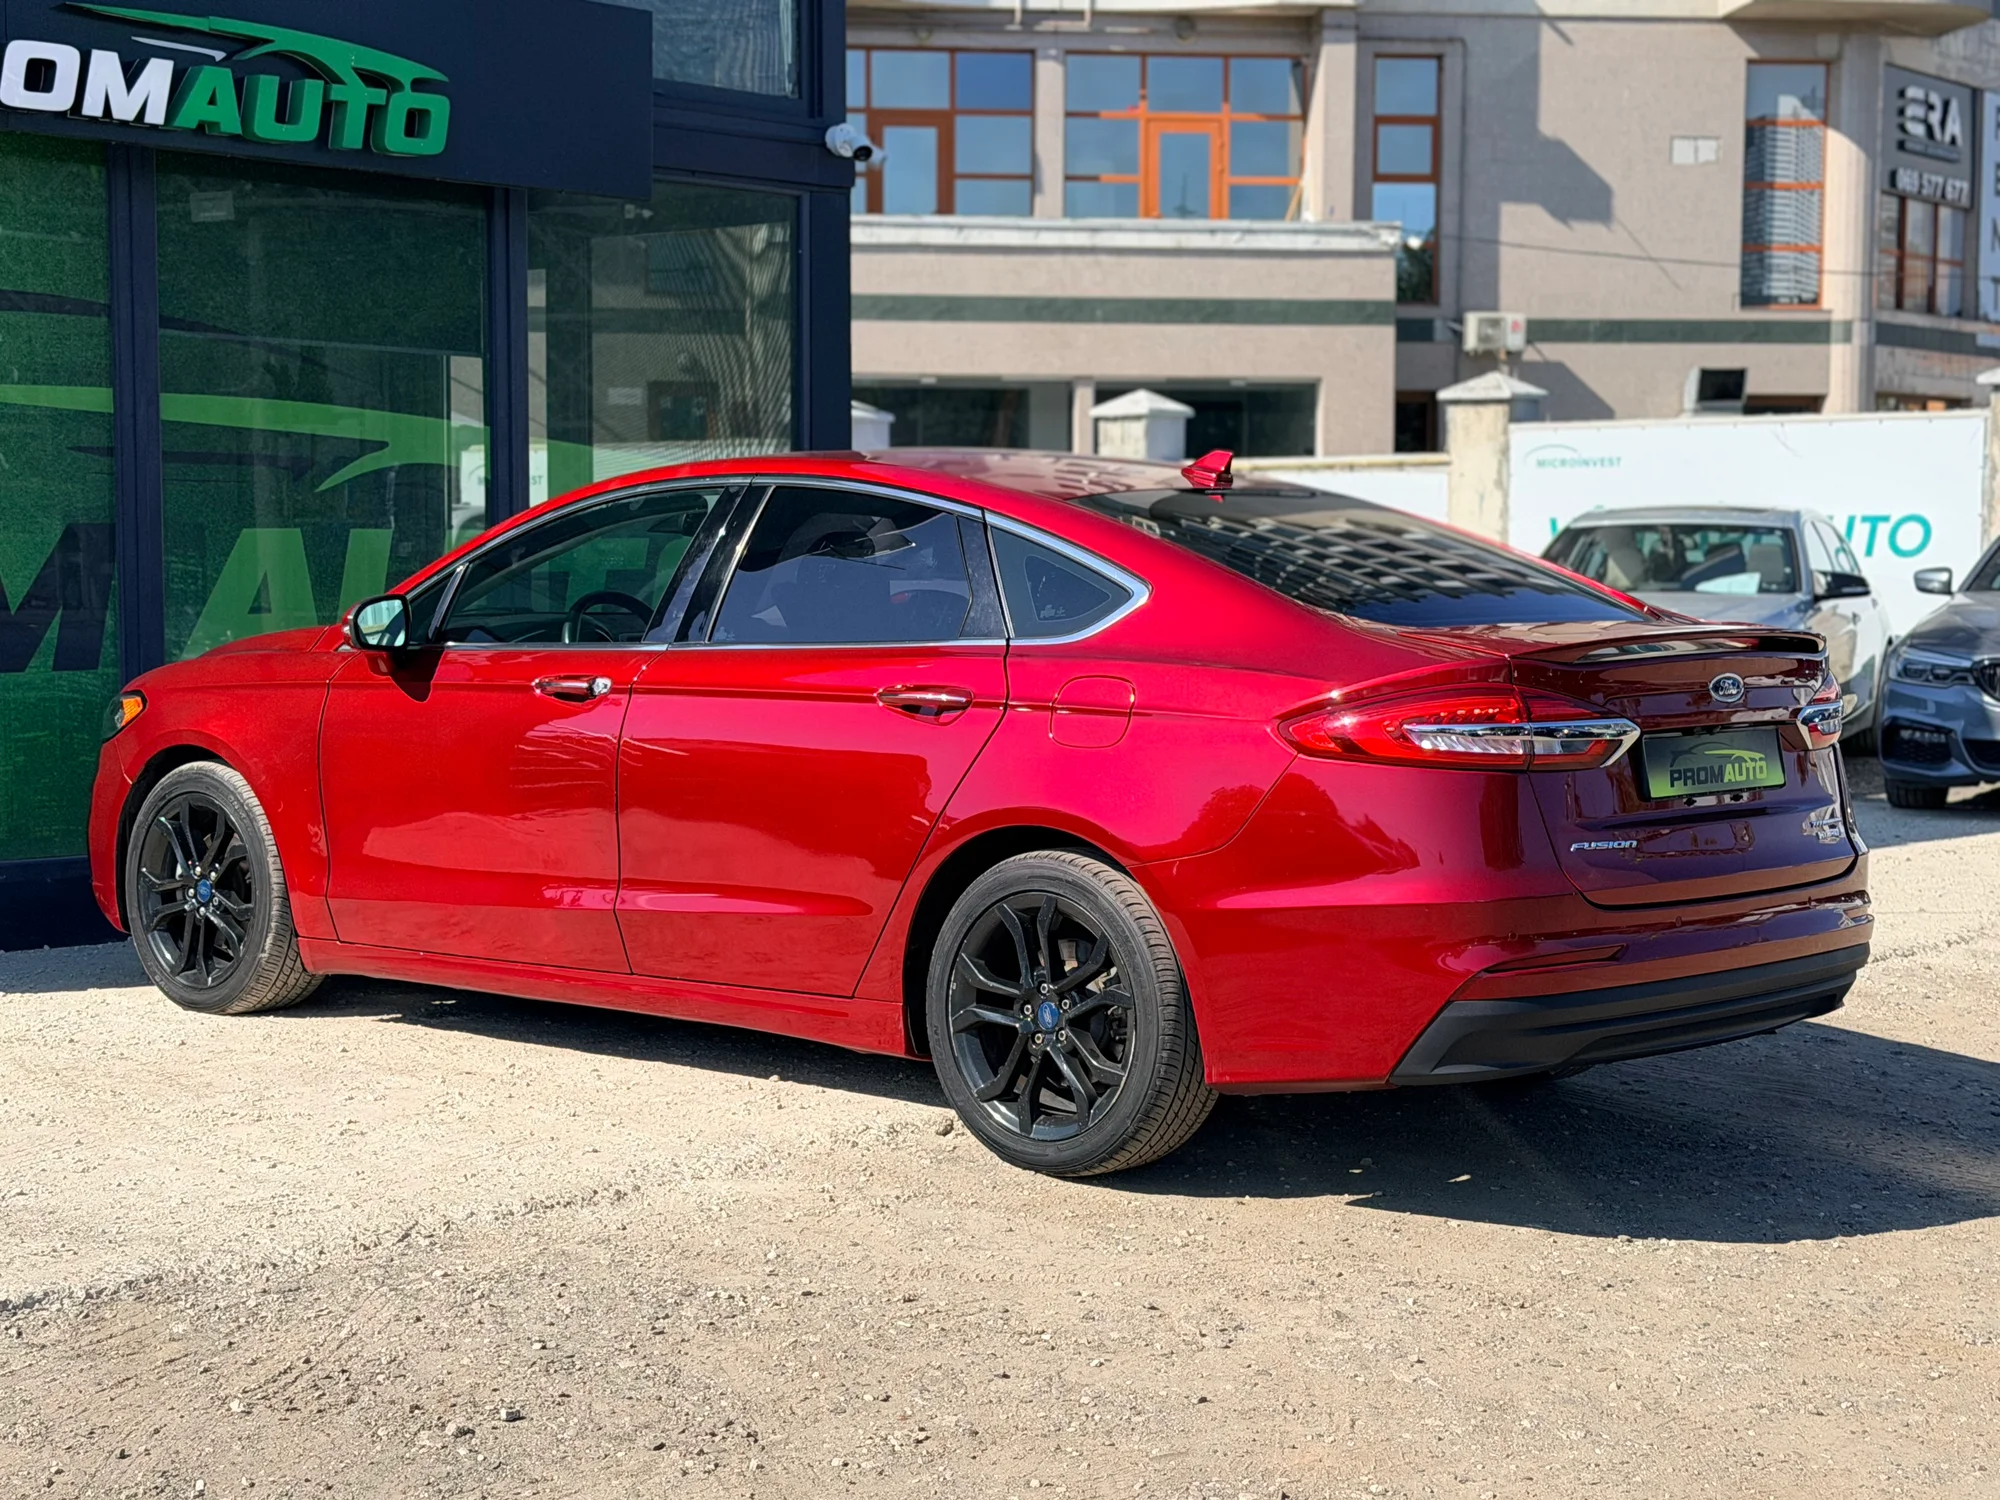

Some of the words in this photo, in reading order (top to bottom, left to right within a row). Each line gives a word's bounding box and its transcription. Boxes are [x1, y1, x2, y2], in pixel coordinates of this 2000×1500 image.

[1904, 85, 1963, 147] ERA
[1536, 456, 1622, 469] MICROINVEST
[1669, 760, 1768, 789] PROMAUTO
